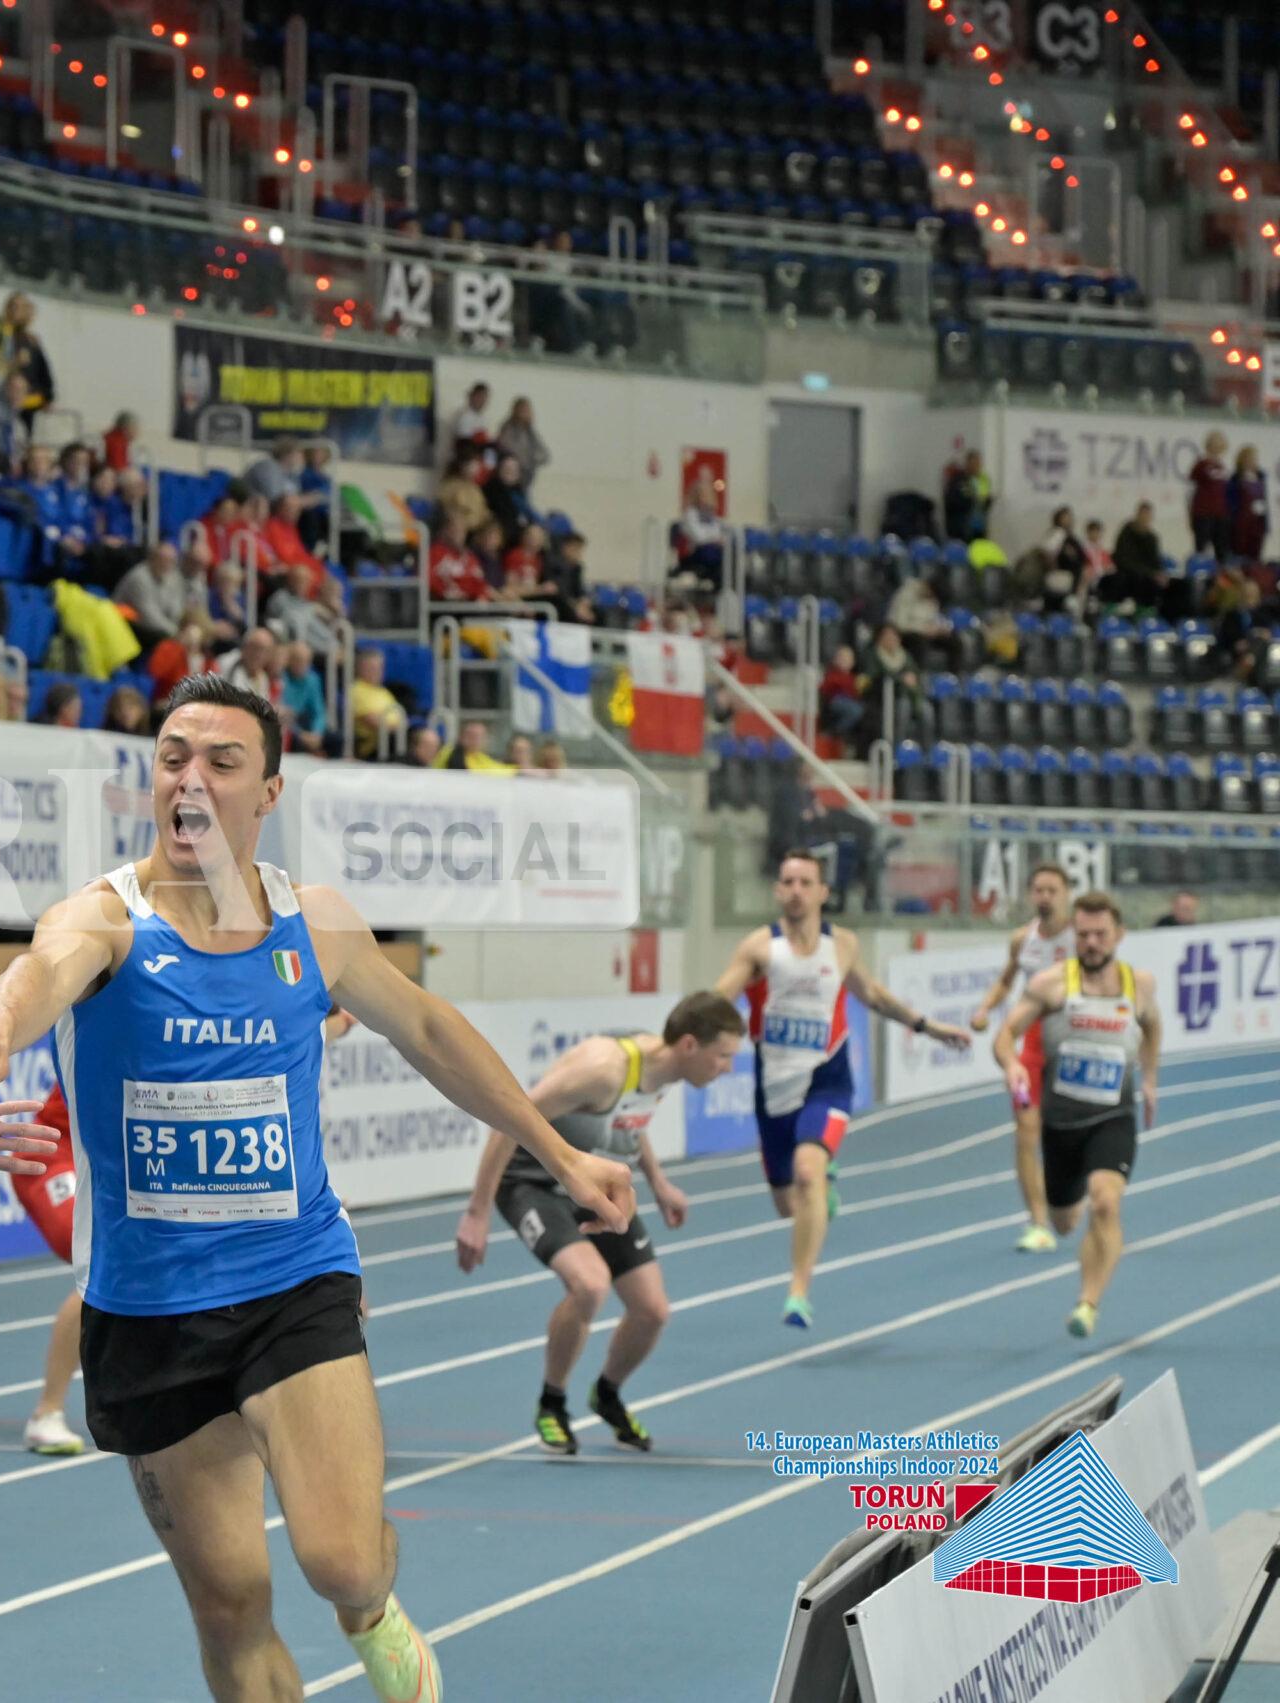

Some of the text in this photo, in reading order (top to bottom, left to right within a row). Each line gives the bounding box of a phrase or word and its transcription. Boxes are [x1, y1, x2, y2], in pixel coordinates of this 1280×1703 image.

[1037, 3, 1099, 60] C3
[381, 259, 514, 336] A2 B2
[980, 838, 1019, 900] A1
[1229, 939, 1280, 1002] TZ
[163, 1017, 277, 1045] ITALIA
[133, 1125, 178, 1155] 35
[189, 1123, 287, 1175] 1238
[146, 1158, 166, 1176] M
[149, 1181, 271, 1191] ITA Raffaele CINQUEGRANA
